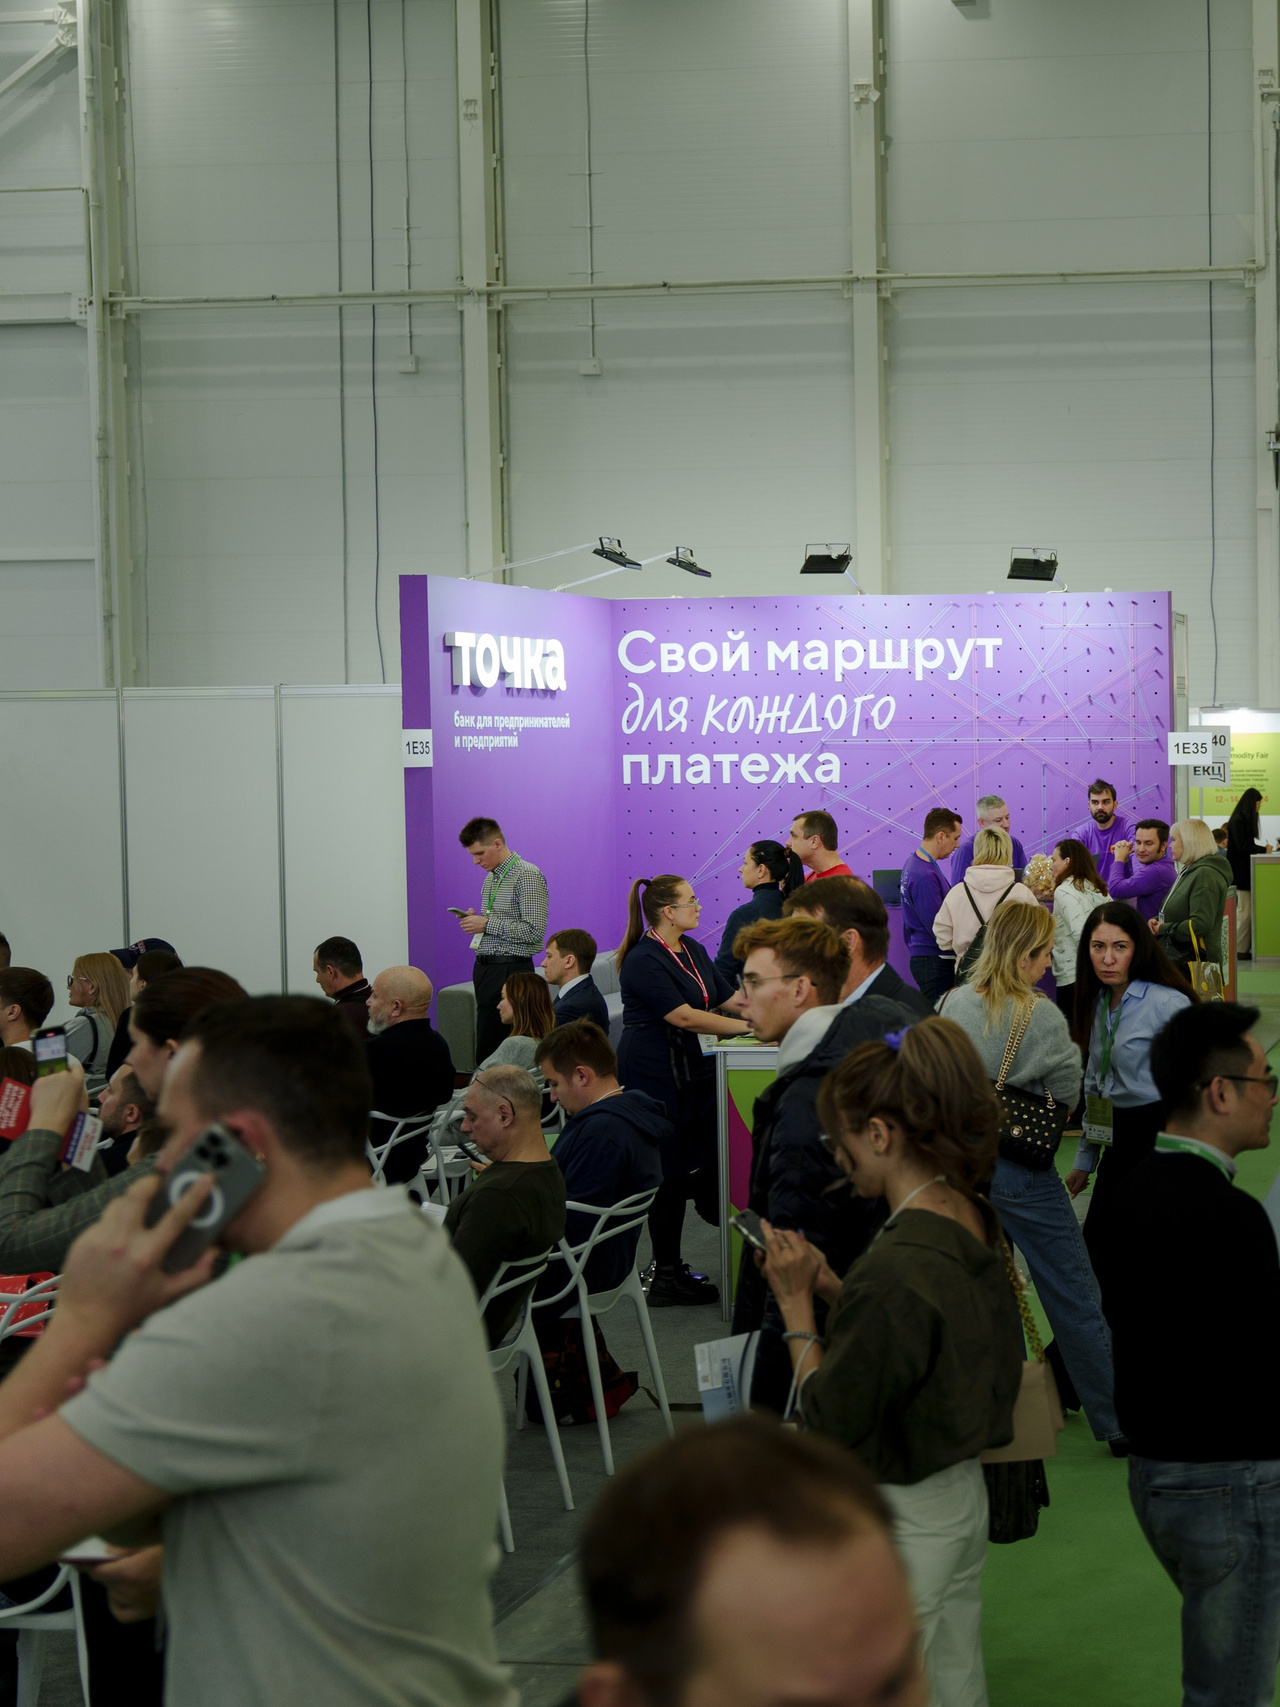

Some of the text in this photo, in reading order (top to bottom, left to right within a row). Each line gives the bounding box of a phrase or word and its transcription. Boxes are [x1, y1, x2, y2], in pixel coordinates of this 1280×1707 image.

[617, 629, 1003, 681] Свой маршрут
[621, 682, 689, 735] для
[453, 710, 571, 732] банк для предпринимателей
[405, 741, 430, 755] 1E35
[454, 732, 519, 752] и предприятий
[1174, 742, 1208, 755] 1E35
[1230, 752, 1254, 760] modity
[621, 752, 842, 786] платежа
[1193, 766, 1223, 778] ЕКЦ
